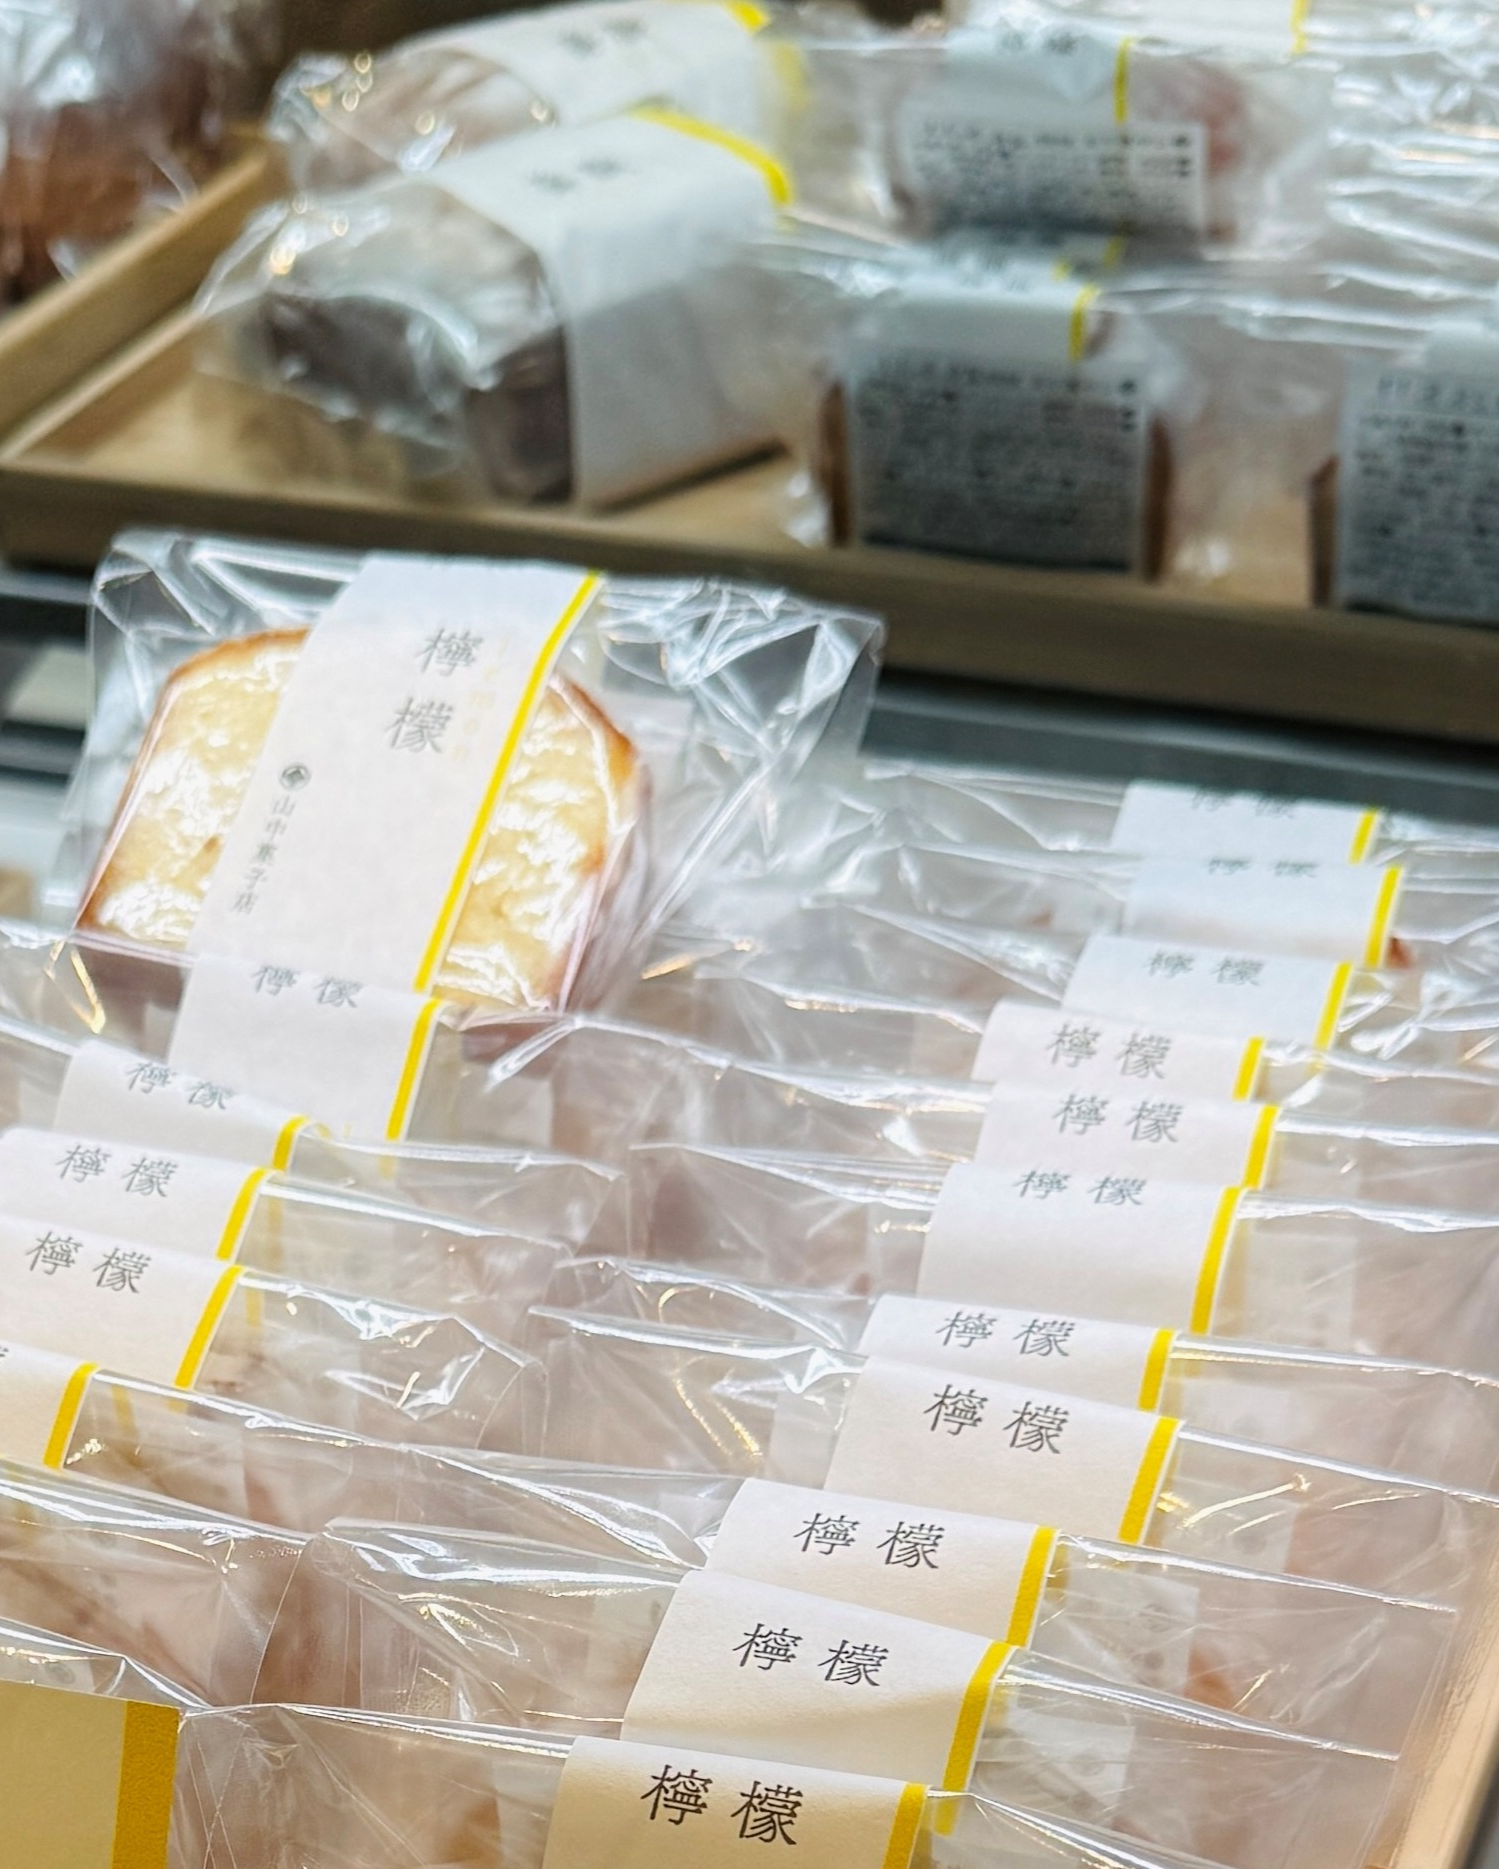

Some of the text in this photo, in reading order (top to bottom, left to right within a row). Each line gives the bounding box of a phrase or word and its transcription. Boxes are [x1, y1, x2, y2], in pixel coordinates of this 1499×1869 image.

[383, 626, 485, 755] 檸檬
[1044, 1021, 1173, 1081] 檸檬
[1051, 1091, 1183, 1146] 檸檬
[53, 1142, 180, 1200] 檸檬
[24, 1230, 153, 1296] 檸檬
[935, 1309, 1077, 1359] 檸檬
[923, 1383, 1069, 1455] 檸檬
[793, 1512, 945, 1570] 檸檬
[732, 1622, 890, 1688] 檸檬
[640, 1764, 805, 1847] 檸檬
